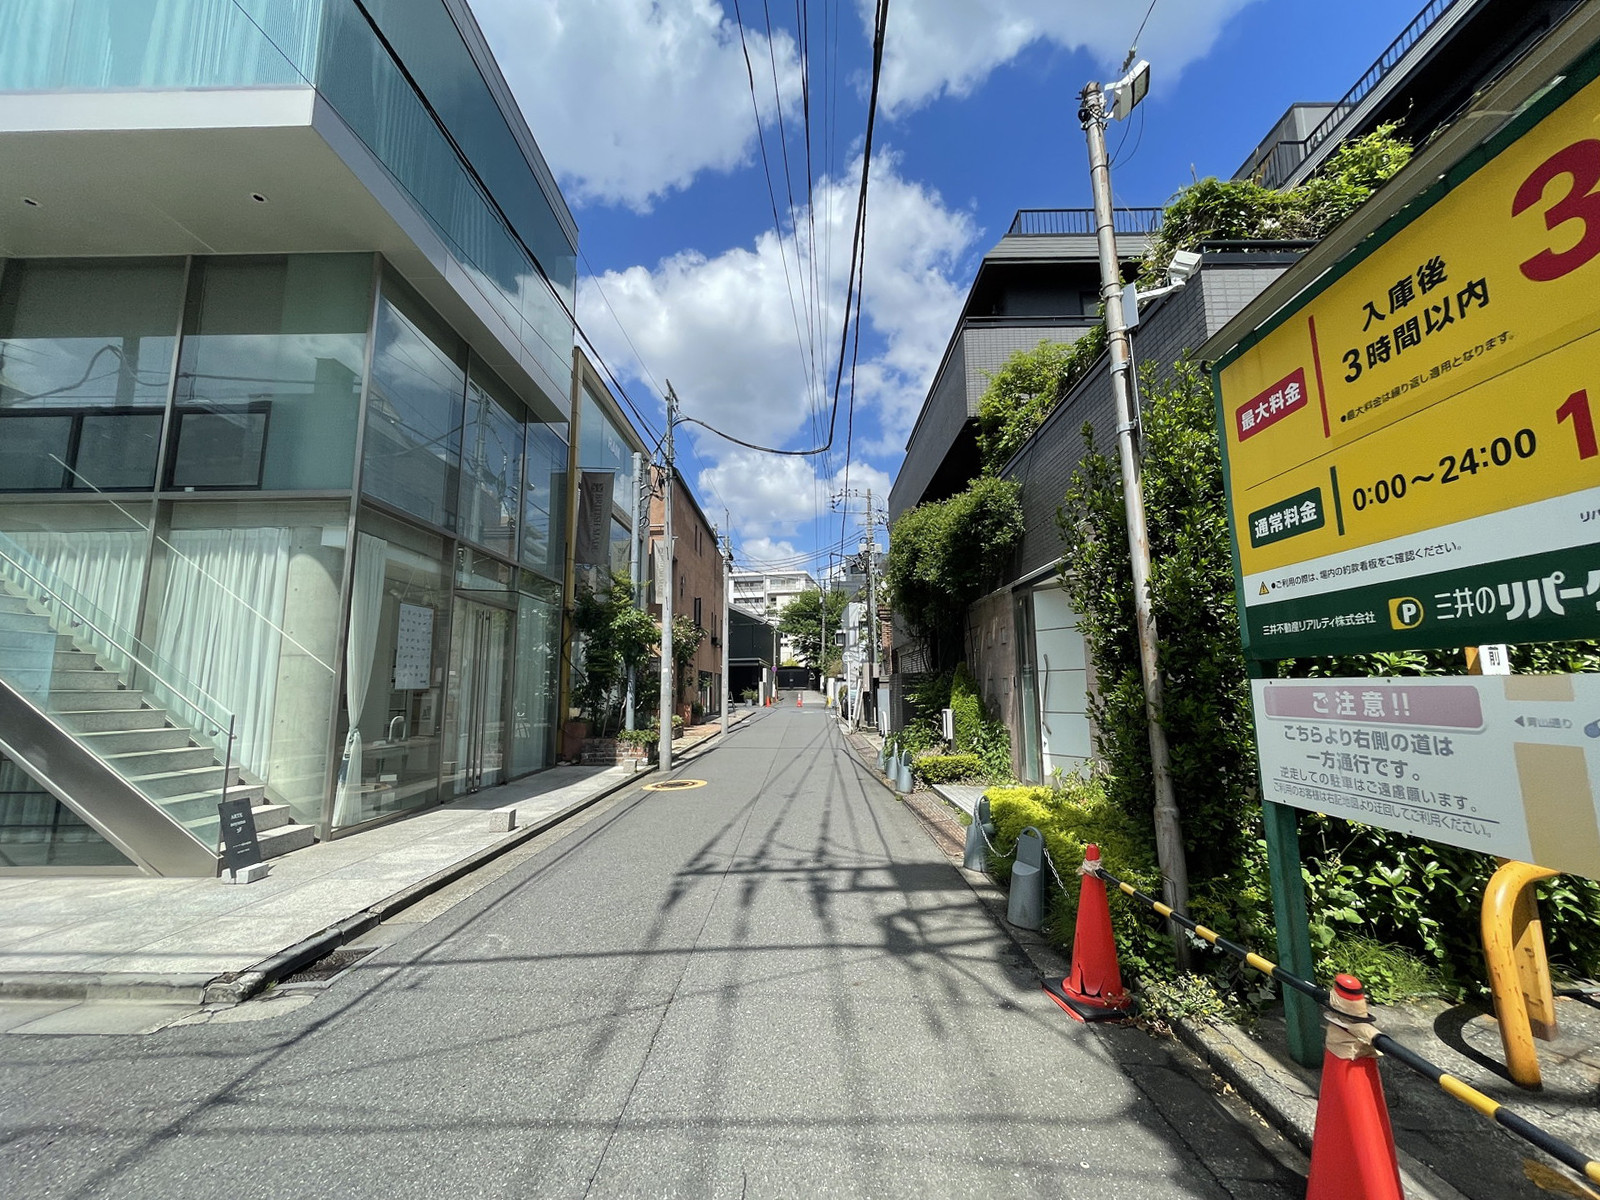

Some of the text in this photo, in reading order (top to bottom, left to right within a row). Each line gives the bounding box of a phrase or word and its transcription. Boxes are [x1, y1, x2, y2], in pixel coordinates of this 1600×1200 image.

[1362, 255, 1448, 331] 入庫後
[1342, 277, 1490, 383] 3時間以内
[1240, 381, 1302, 432] 最大料金
[1556, 388, 1599, 460] 1
[1254, 500, 1318, 539] 通常料金
[1262, 611, 1376, 636] 三井不動産リアルティ株式会社
[1284, 725, 1455, 757] こちらより右側の道は
[1280, 766, 1478, 813] 逆走しての駐車はご遠慮願います。
[1306, 752, 1420, 782] 一方通行です。
